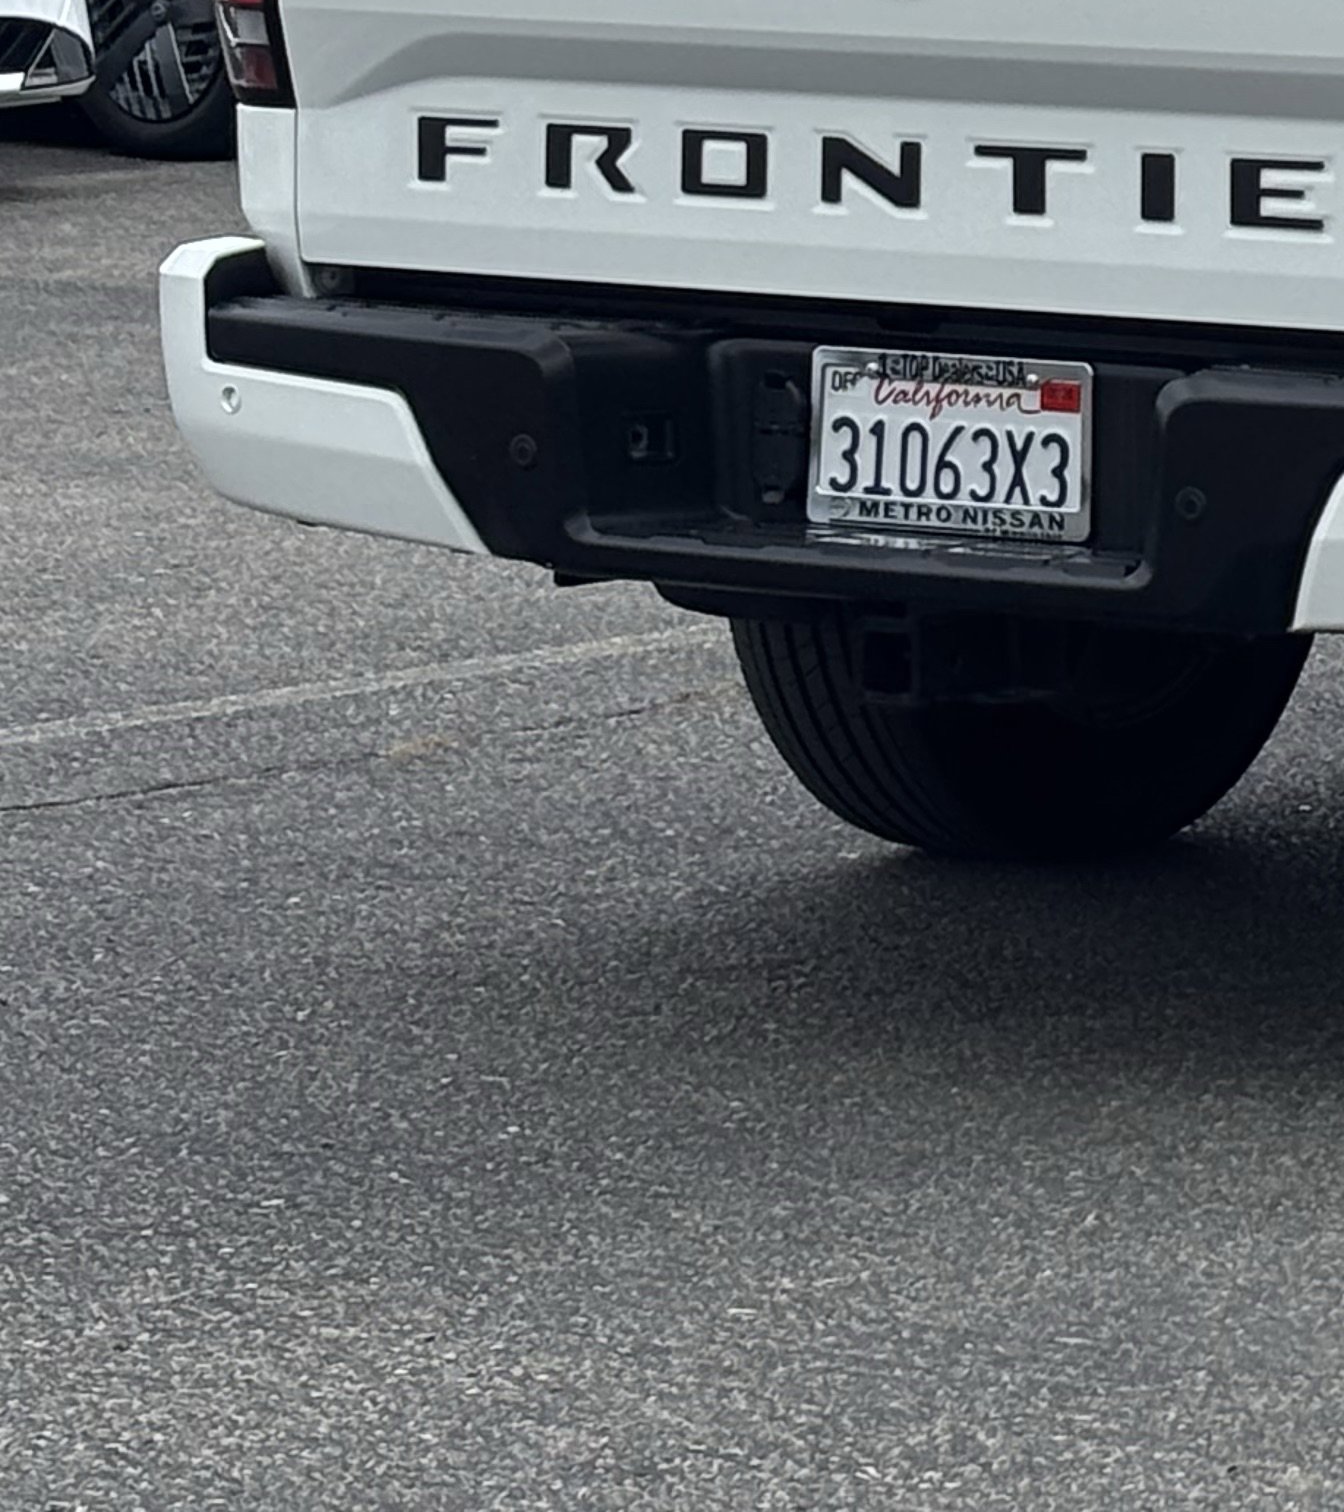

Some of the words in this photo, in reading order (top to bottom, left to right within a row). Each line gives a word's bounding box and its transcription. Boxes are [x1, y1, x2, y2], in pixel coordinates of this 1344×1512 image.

[874, 376, 1041, 421] California
[829, 415, 1070, 509] 31063X3
[859, 500, 953, 524] METRO
[962, 506, 1066, 531] NISSAN
